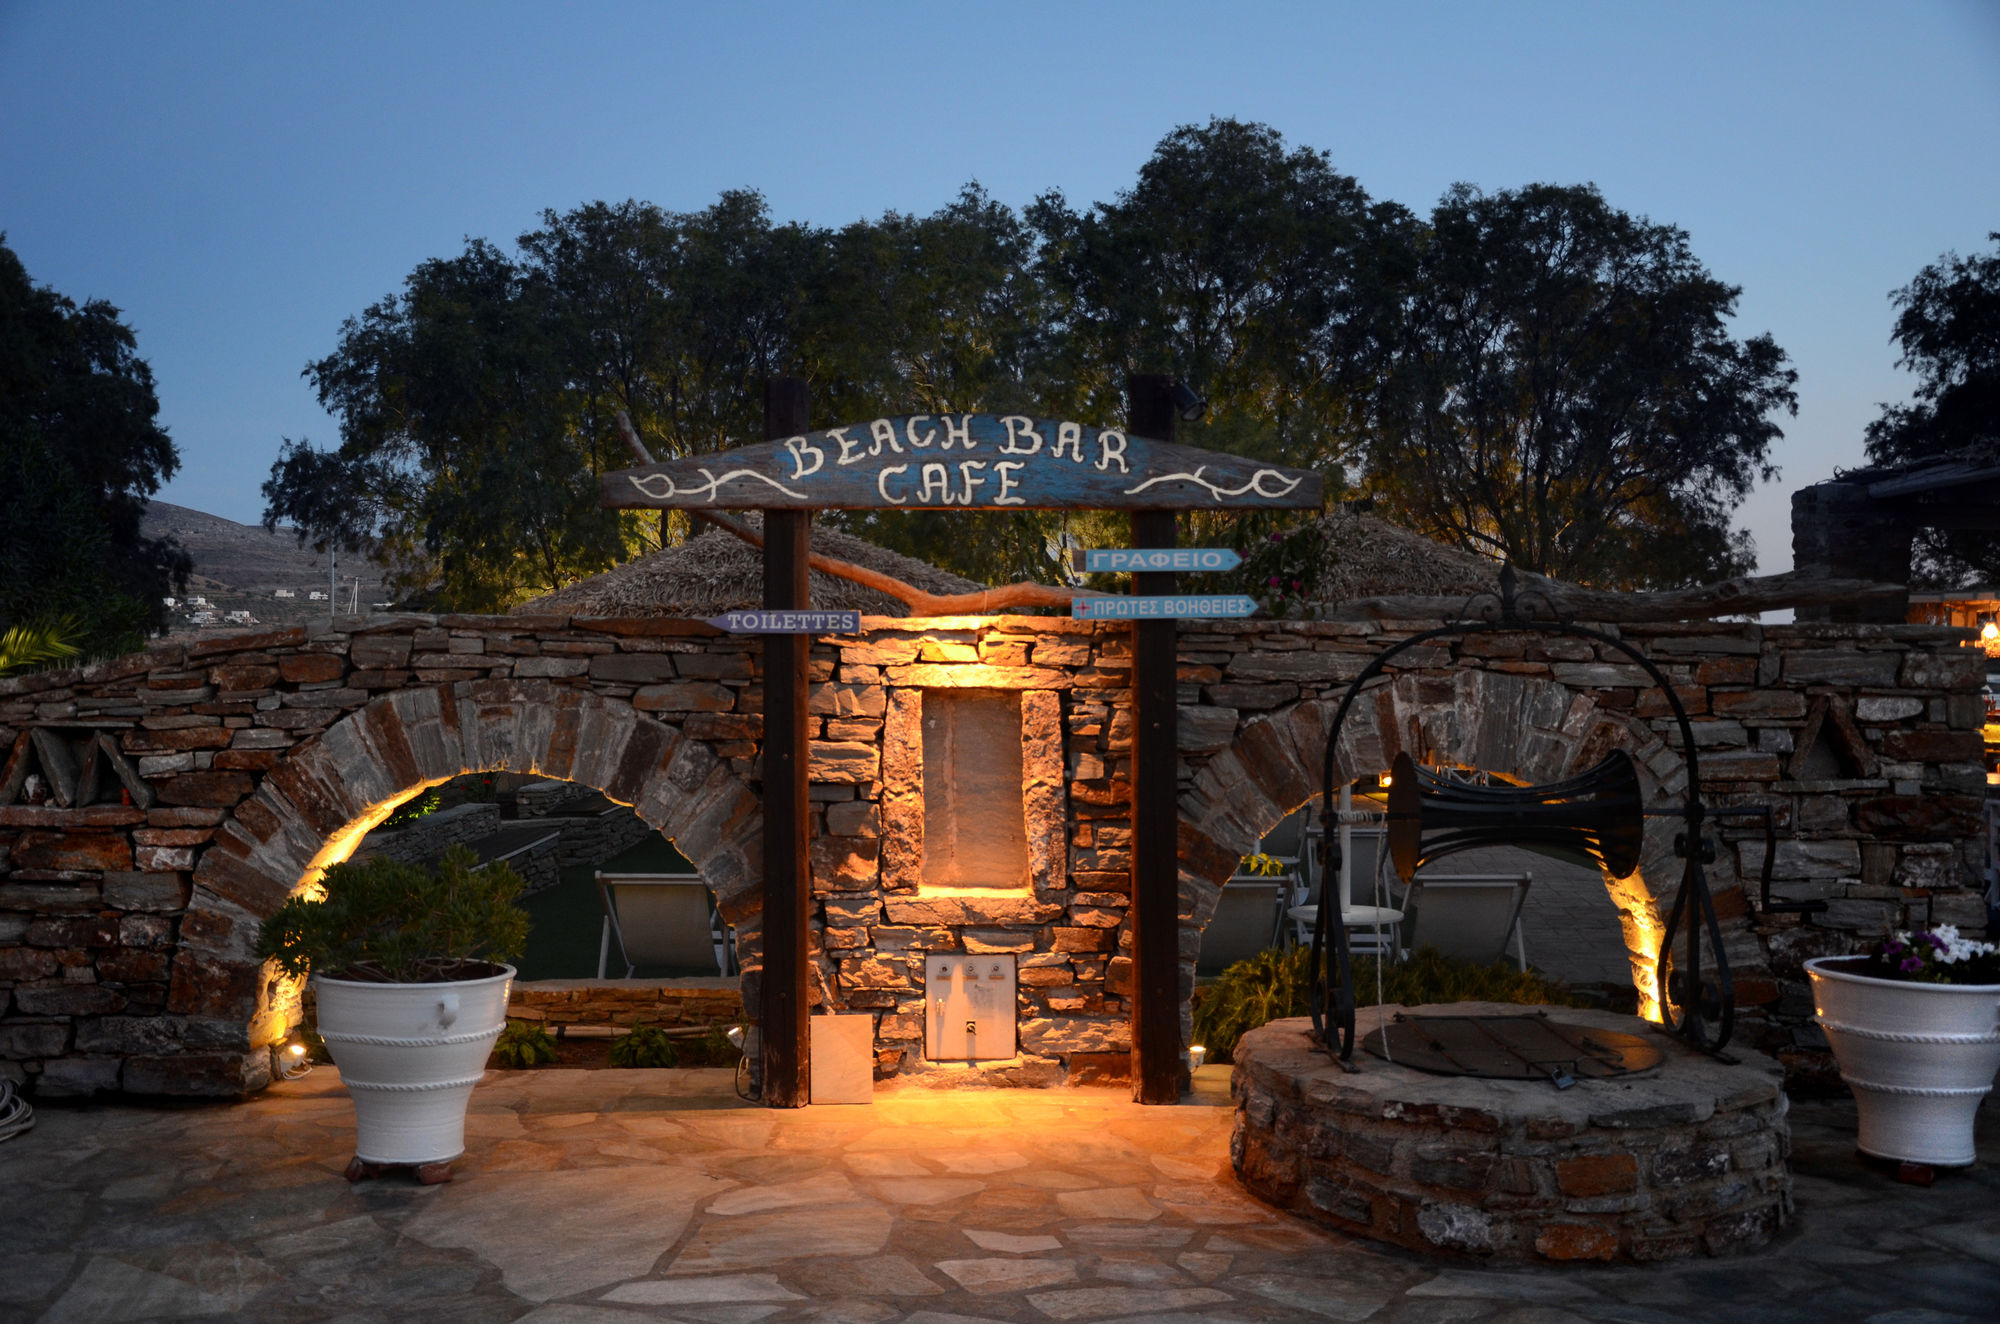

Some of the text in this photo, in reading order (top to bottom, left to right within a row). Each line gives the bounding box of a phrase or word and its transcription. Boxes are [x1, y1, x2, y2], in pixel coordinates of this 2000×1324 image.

[784, 414, 1130, 480] BEACH BAR
[878, 460, 1026, 506] CAFE
[1093, 552, 1222, 568] ΓΡΑΦΕΙΟ
[1094, 599, 1248, 616] ΠΡΩΤΕΣ ΒΟΗΘΕΙΕΣ
[727, 614, 853, 629] TOILETTES
